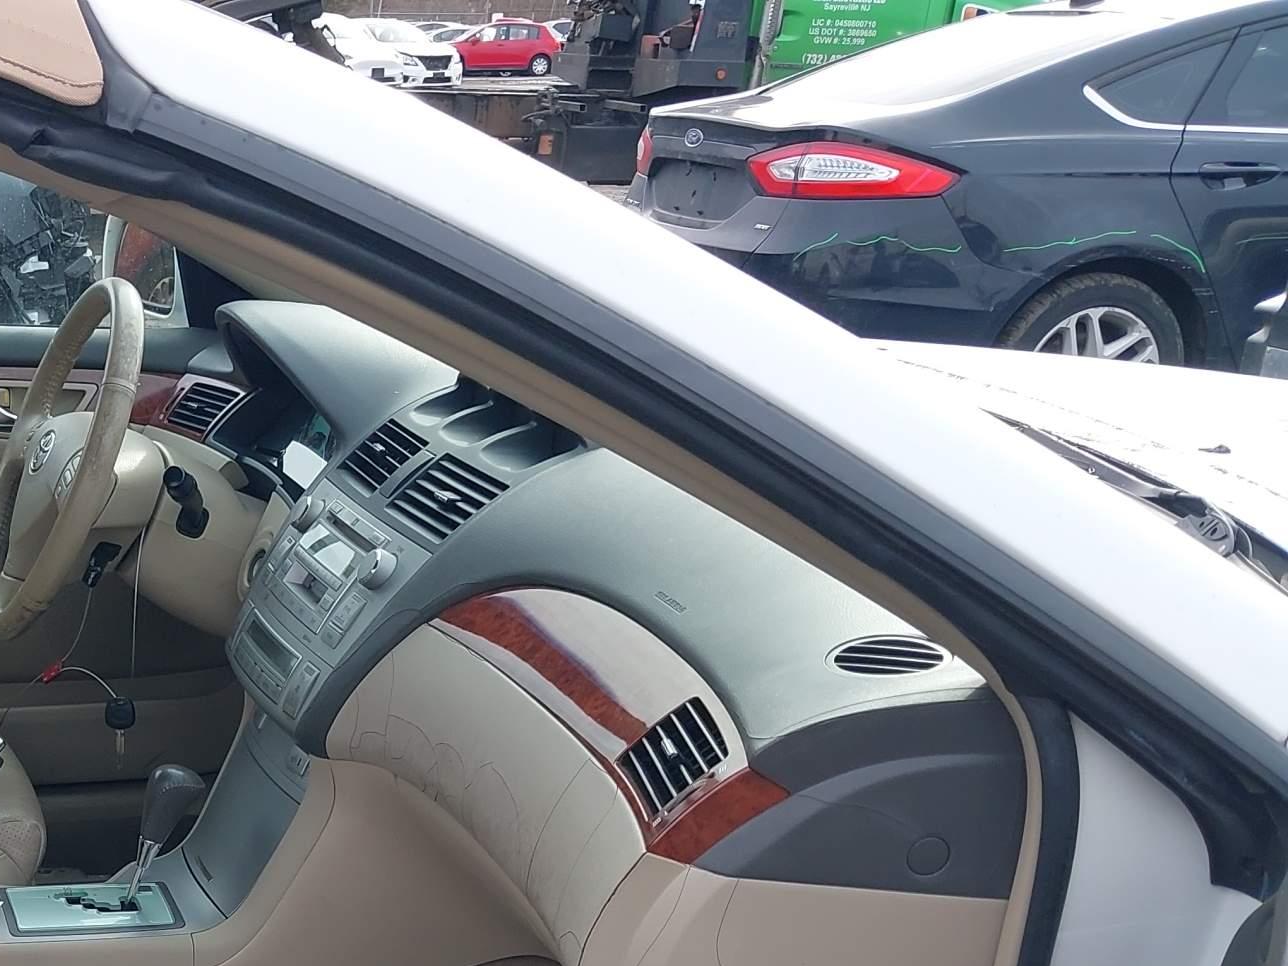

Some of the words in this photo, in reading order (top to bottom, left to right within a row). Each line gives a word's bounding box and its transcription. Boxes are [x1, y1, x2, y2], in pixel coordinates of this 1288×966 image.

[824, 3, 859, 12] Sayreville
[812, 19, 825, 27] LIC
[821, 28, 837, 36] DOT
[814, 36, 832, 44] GVW
[802, 53, 827, 65] (732)
